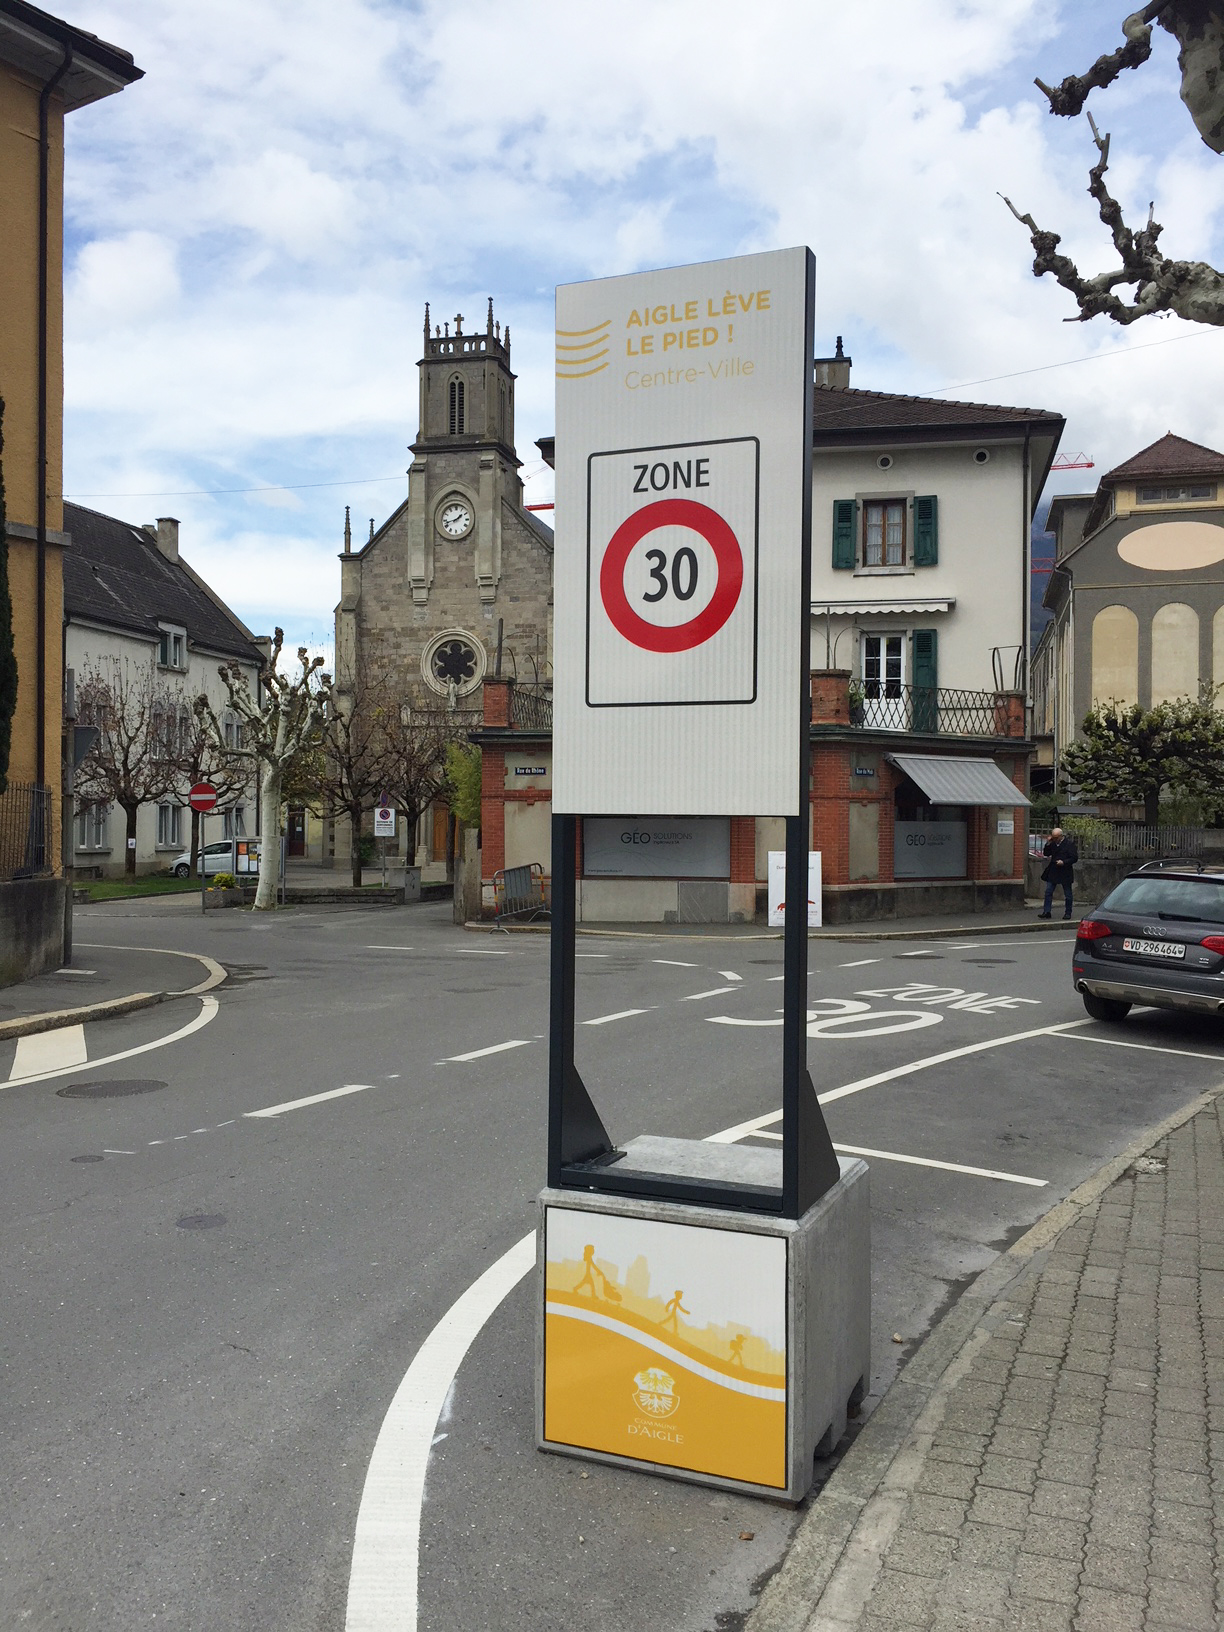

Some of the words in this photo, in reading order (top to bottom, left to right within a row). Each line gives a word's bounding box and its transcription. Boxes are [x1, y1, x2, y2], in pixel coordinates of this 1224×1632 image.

[626, 301, 698, 329] AIGLE
[708, 290, 772, 318] LÈVE
[626, 335, 654, 356] LE
[624, 356, 754, 391] Centre-Ville
[633, 458, 710, 493] ZONE
[642, 546, 698, 603] 30
[620, 826, 651, 844] GÉO
[653, 832, 693, 840] SOLUTIONS
[905, 831, 926, 846] GÉO
[853, 982, 1043, 1015] ZONE
[704, 998, 944, 1039] 30
[627, 1424, 684, 1444] D'AIGLE
[634, 1417, 677, 1430] COMMUNE
